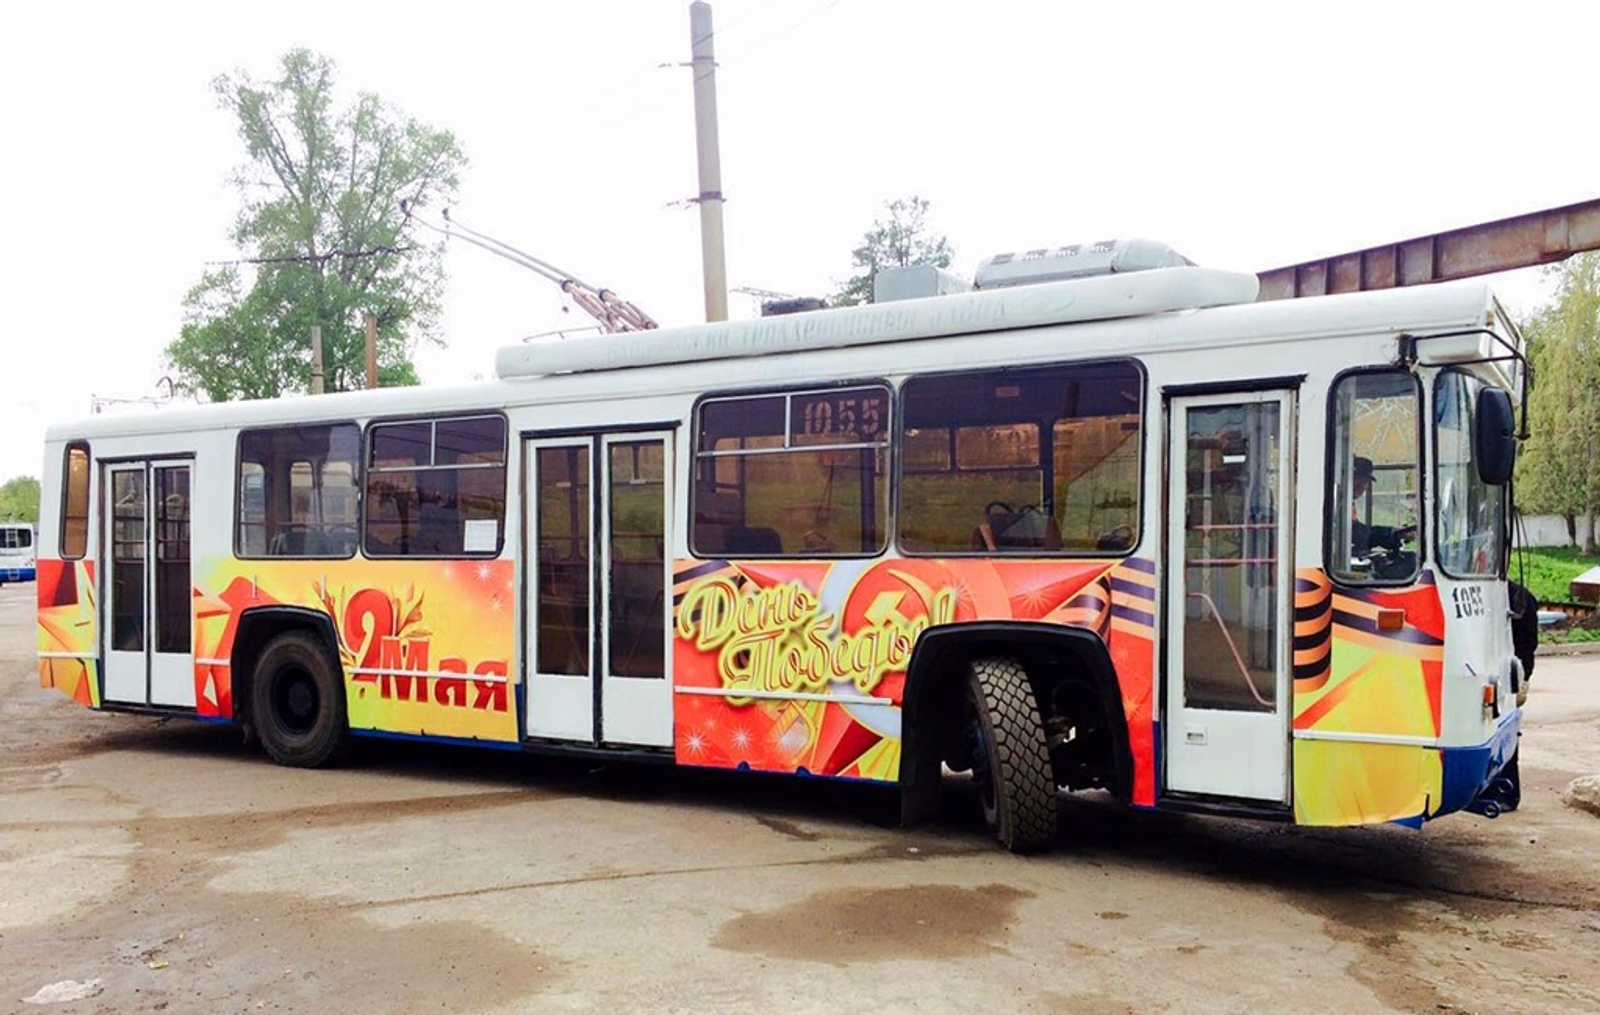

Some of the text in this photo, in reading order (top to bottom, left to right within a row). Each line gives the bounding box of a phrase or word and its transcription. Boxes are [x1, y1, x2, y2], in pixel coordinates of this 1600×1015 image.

[803, 399, 880, 437] 1055
[678, 581, 815, 648] День
[1451, 586, 1486, 619] 1055
[344, 587, 508, 713] 9 Мая
